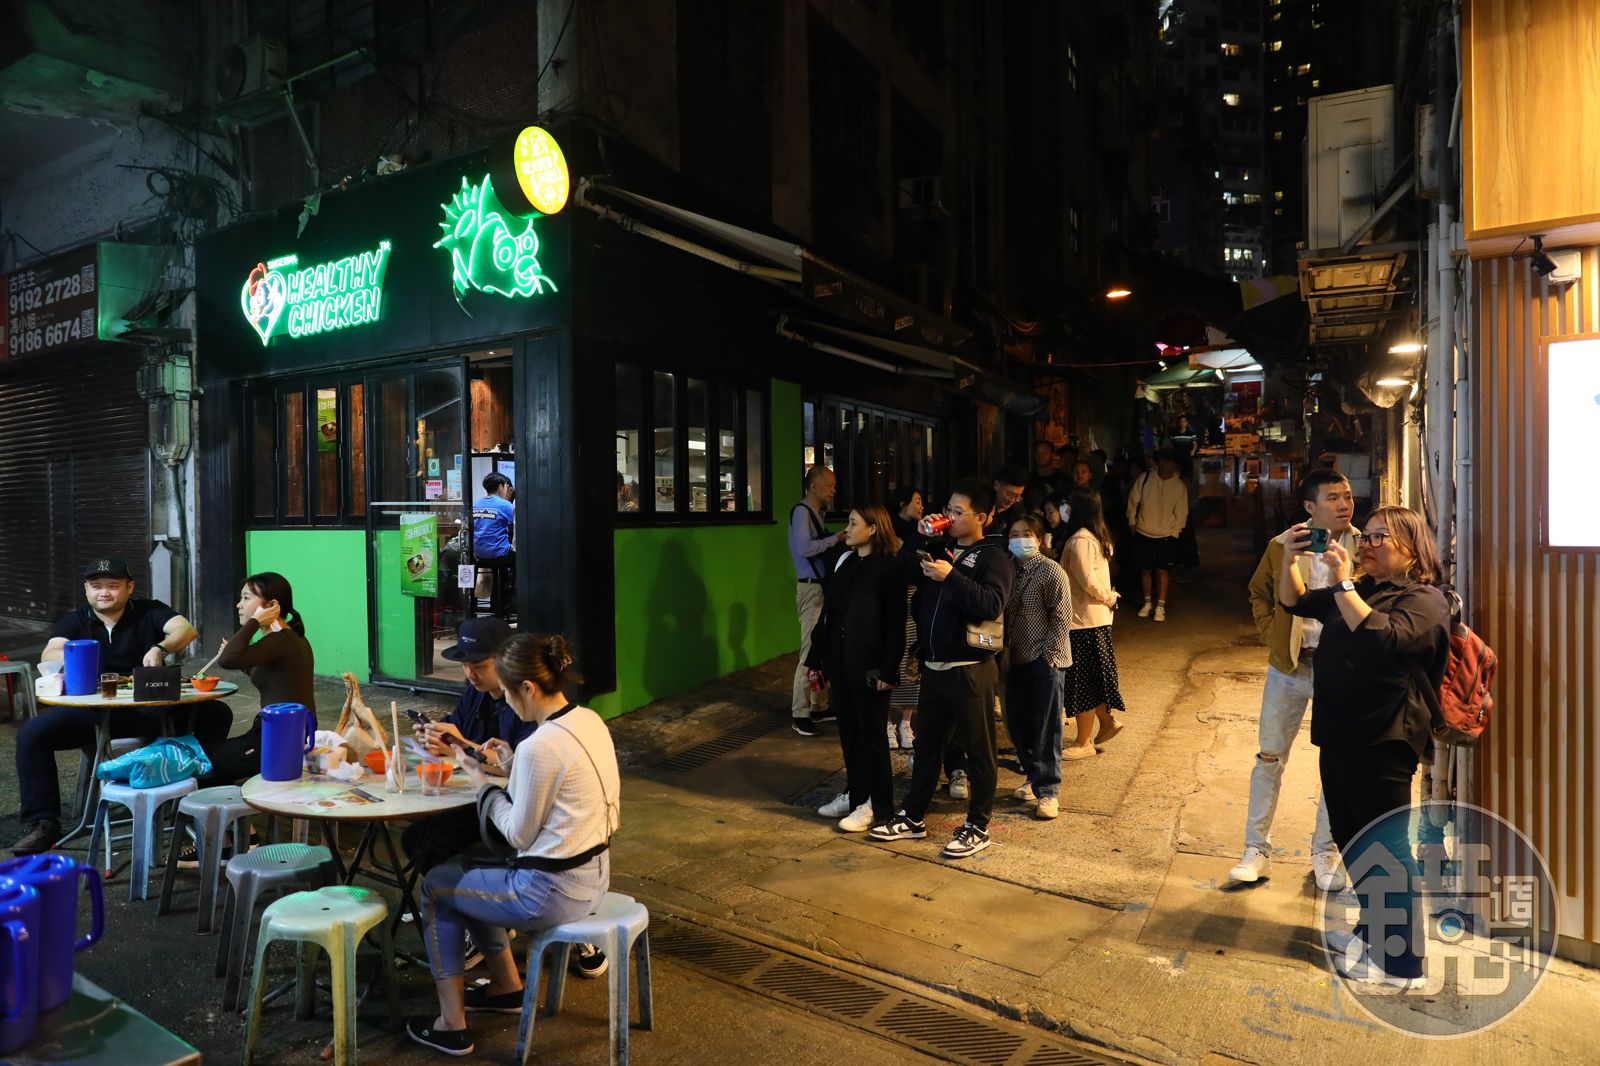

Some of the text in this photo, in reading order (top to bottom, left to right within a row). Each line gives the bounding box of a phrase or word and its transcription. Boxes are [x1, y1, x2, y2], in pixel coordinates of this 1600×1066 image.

[9, 287, 43, 315] 9192
[45, 274, 81, 304] 2728
[287, 249, 383, 304] HEALTHY
[287, 286, 382, 339] CHICKEN
[9, 328, 43, 356] 9186
[45, 317, 81, 347] 6674
